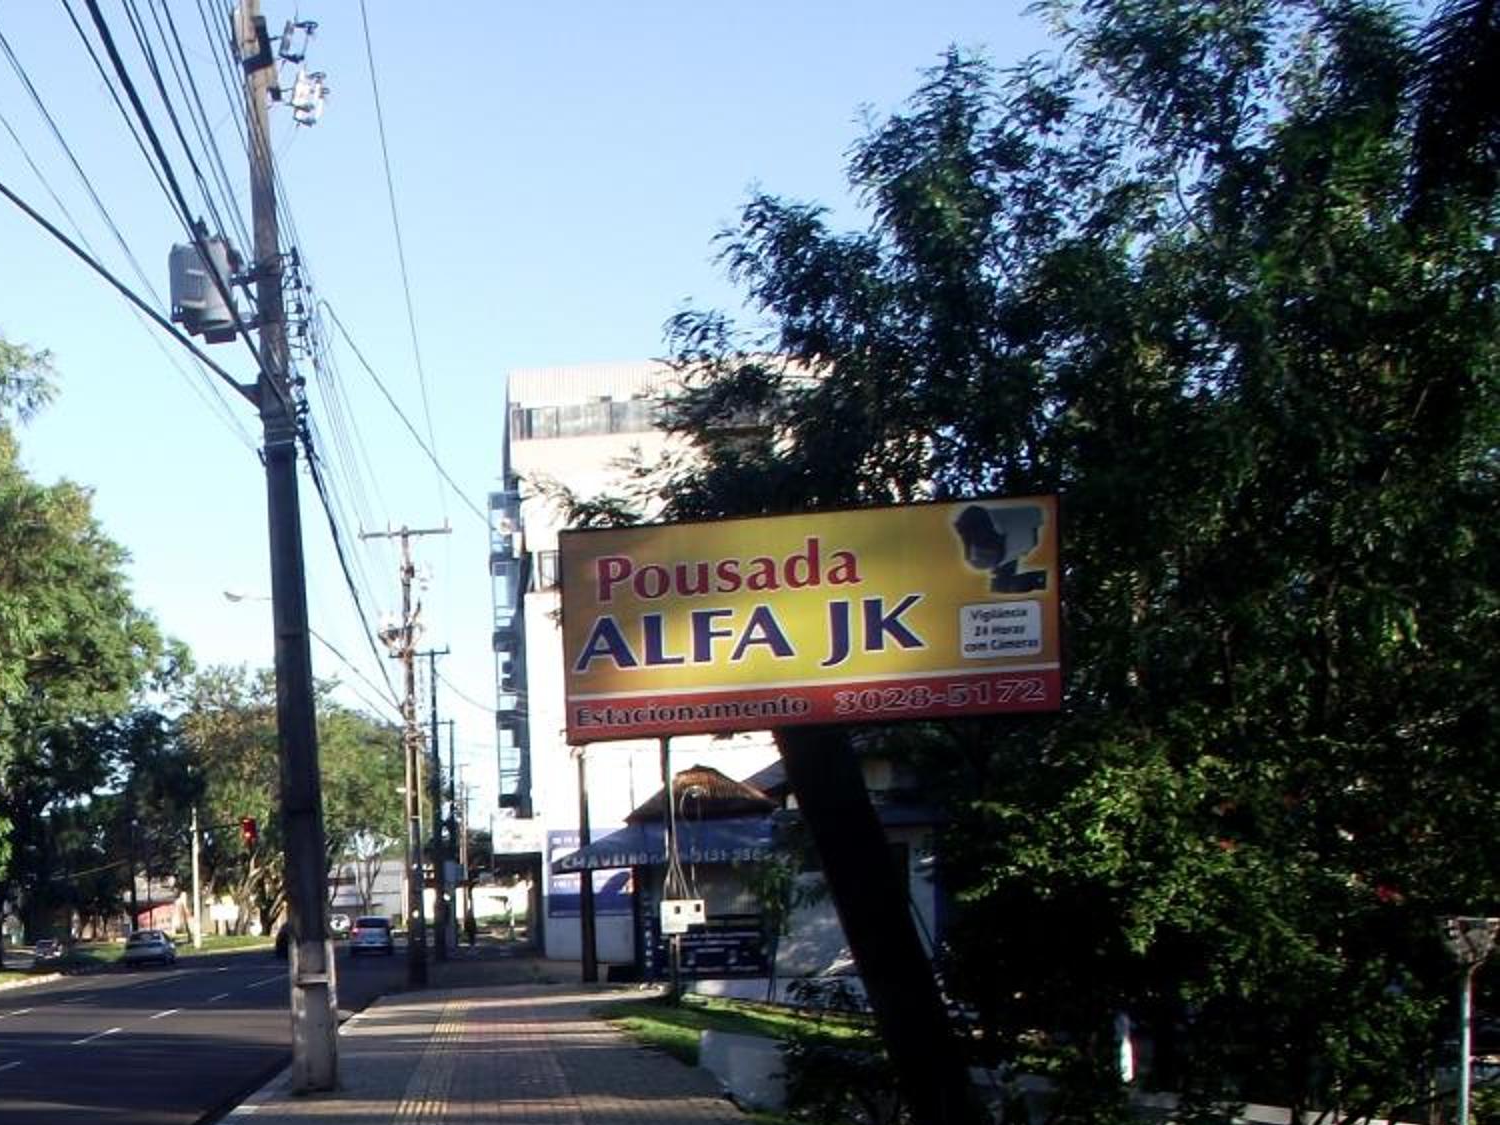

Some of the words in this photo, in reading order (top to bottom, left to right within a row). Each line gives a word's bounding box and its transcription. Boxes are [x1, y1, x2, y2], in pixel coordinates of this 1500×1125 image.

[594, 537, 862, 604] Pousada
[574, 603, 796, 673] ALFA
[820, 593, 928, 667] JK
[574, 697, 811, 729] Estacionamento
[833, 679, 1047, 715] 3028-5172
